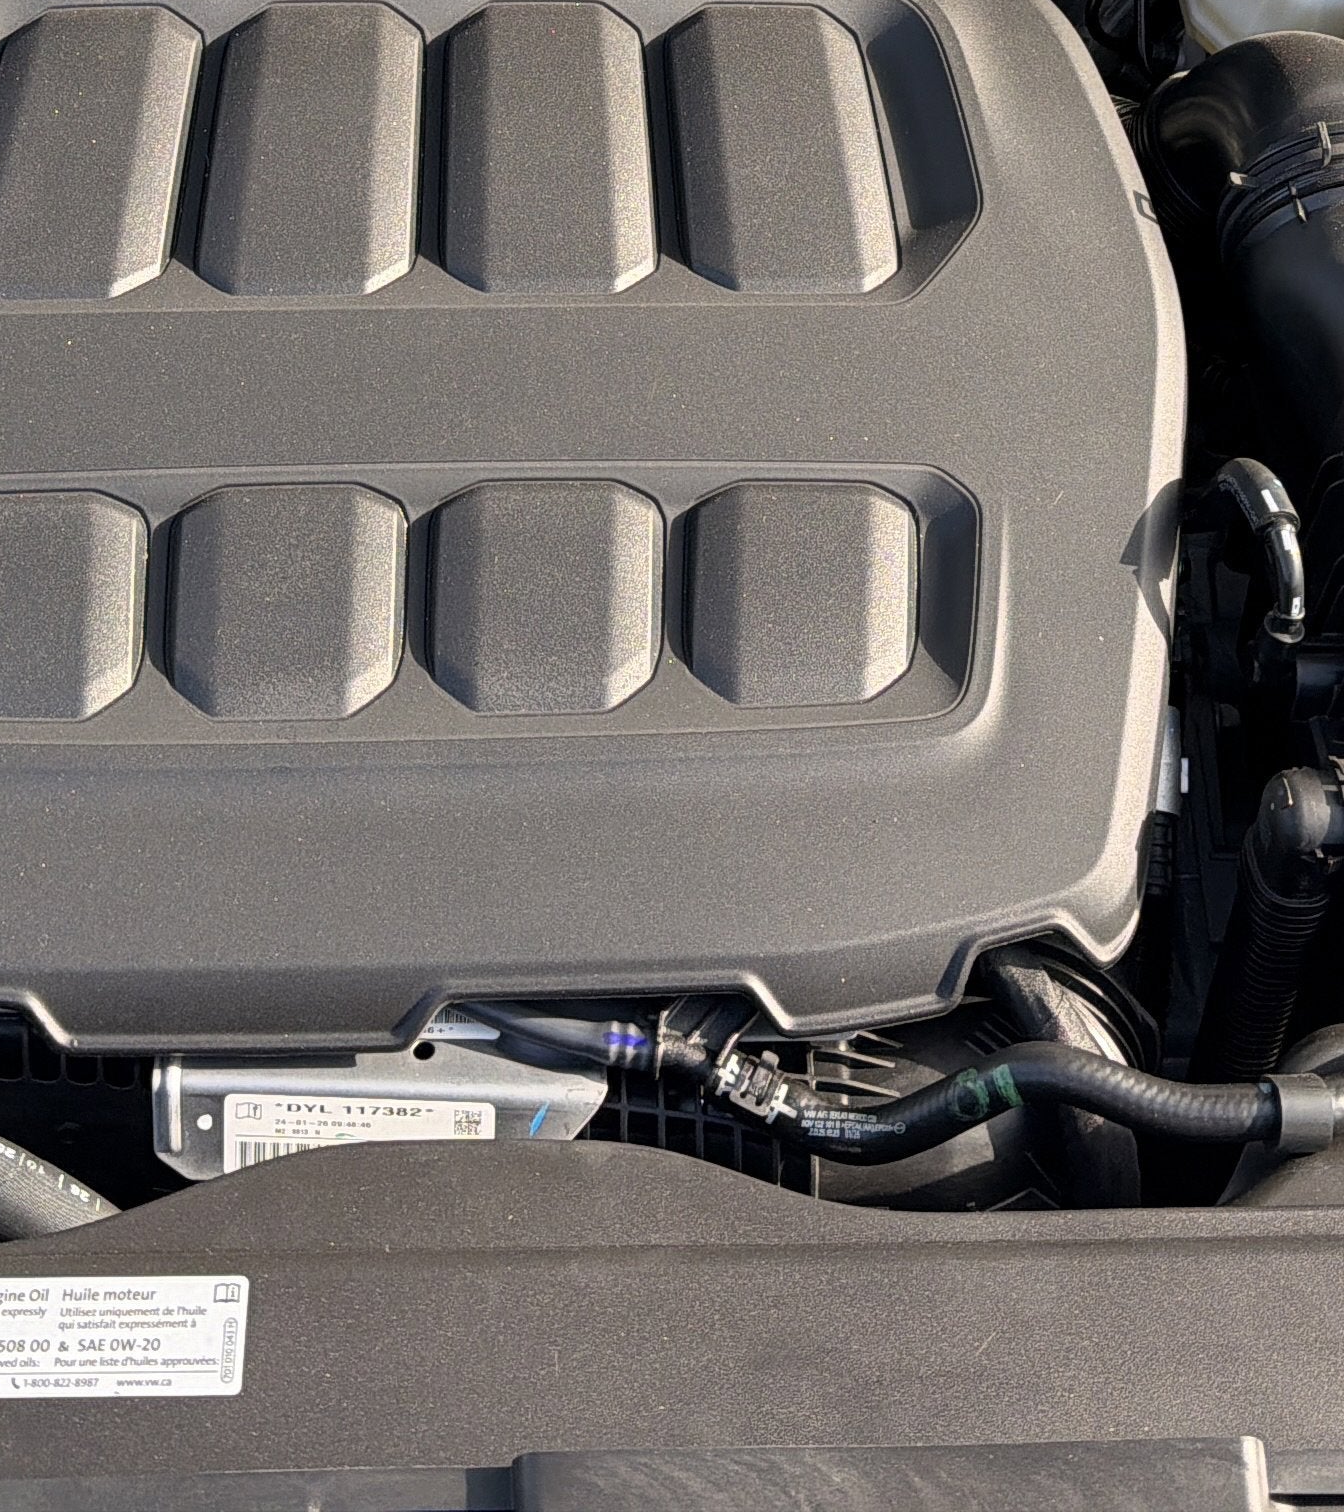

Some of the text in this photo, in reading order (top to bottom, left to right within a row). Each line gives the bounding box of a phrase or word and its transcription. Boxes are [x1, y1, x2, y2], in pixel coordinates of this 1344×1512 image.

[29, 1288, 49, 1302] Oil
[62, 1288, 100, 1301] Huile
[103, 1288, 157, 1301] moteur
[1, 1307, 47, 1319] expressly
[60, 1307, 96, 1317] Utilisez
[99, 1306, 160, 1318] uniquement
[162, 1306, 174, 1315] de
[58, 1320, 75, 1332] qui
[77, 1319, 116, 1329] satisfait
[119, 1319, 188, 1330] expressément
[30, 1339, 50, 1352] 00
[58, 1341, 69, 1351] &
[77, 1338, 106, 1352] SAE
[110, 1338, 161, 1351] 0W-20
[54, 1357, 76, 1367] Pour
[78, 1358, 97, 1367] une
[100, 1357, 120, 1366] liste
